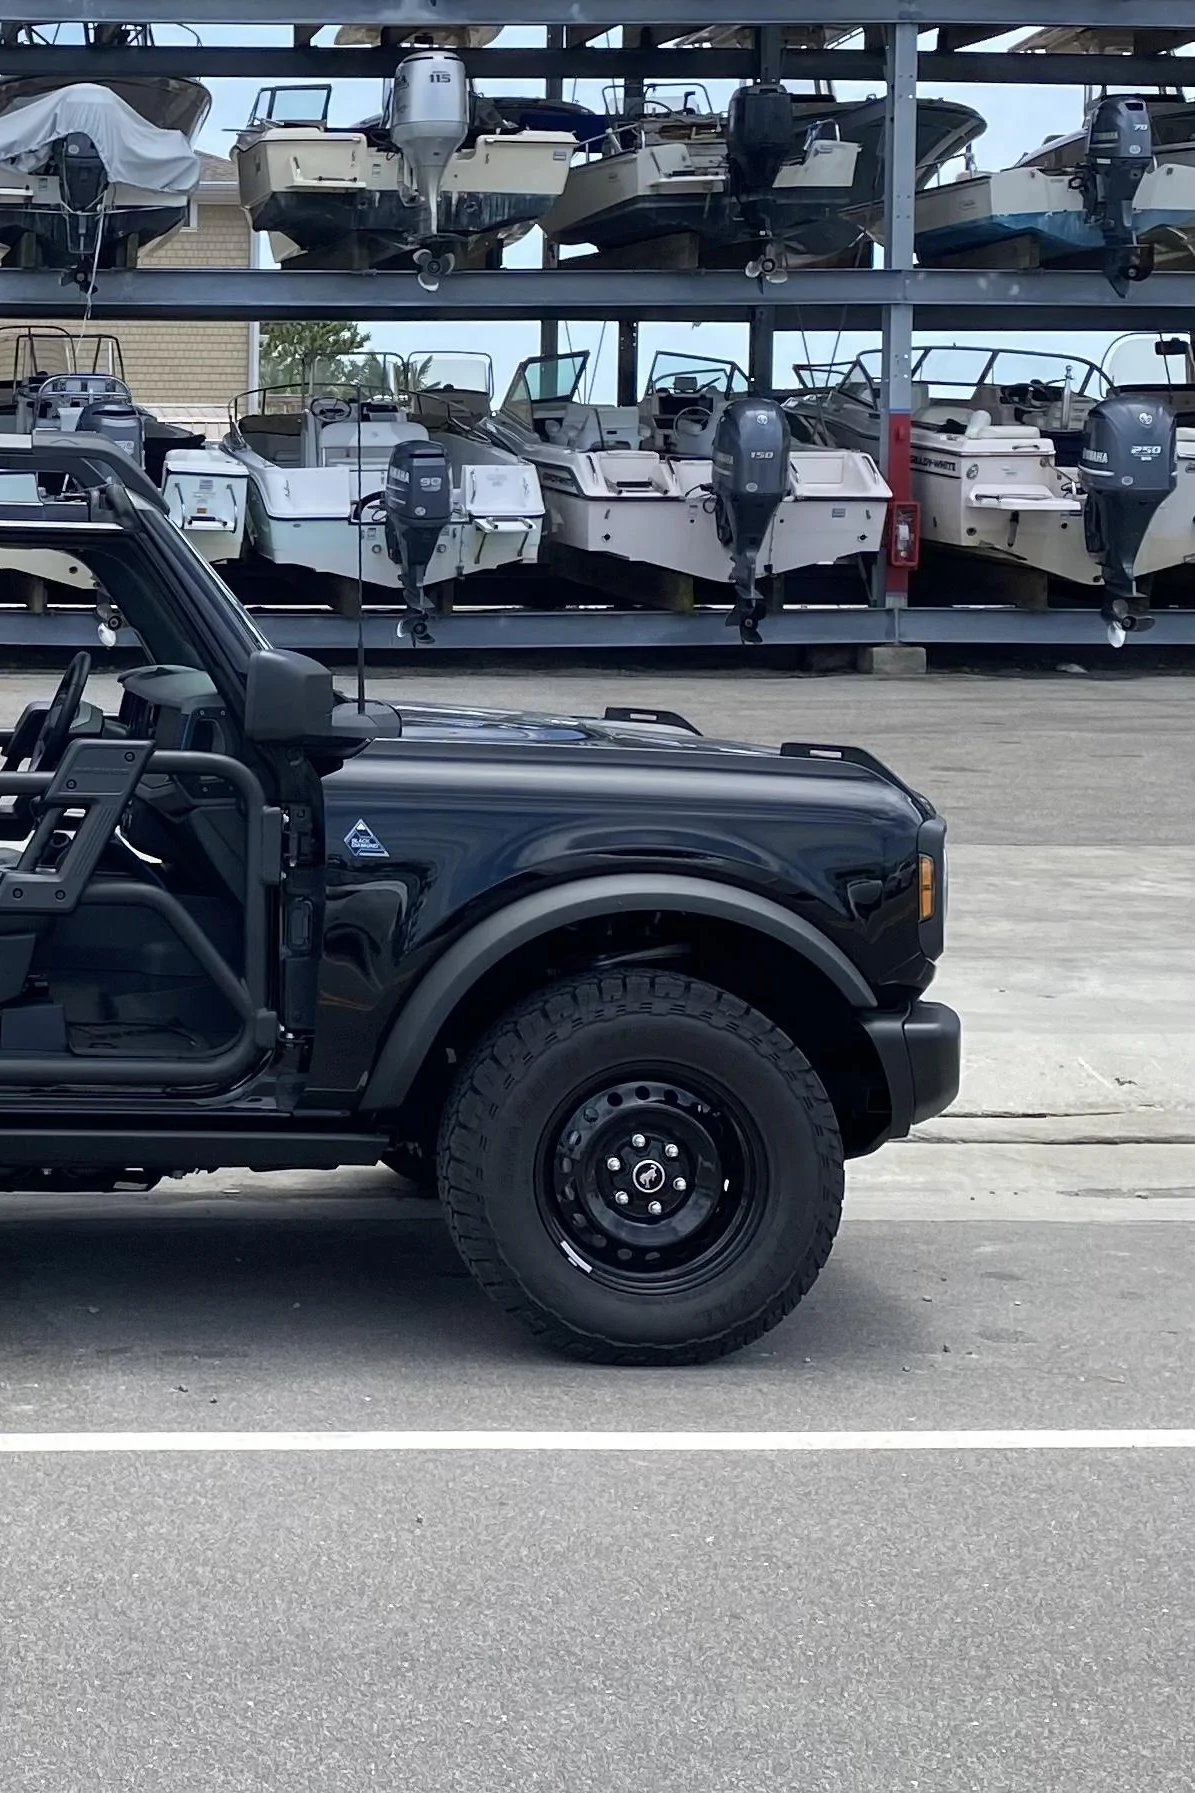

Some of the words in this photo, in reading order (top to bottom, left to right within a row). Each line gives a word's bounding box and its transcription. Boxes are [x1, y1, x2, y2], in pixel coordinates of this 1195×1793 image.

[429, 73, 452, 84] 115
[1131, 445, 1162, 454] 250
[750, 451, 774, 459] 150
